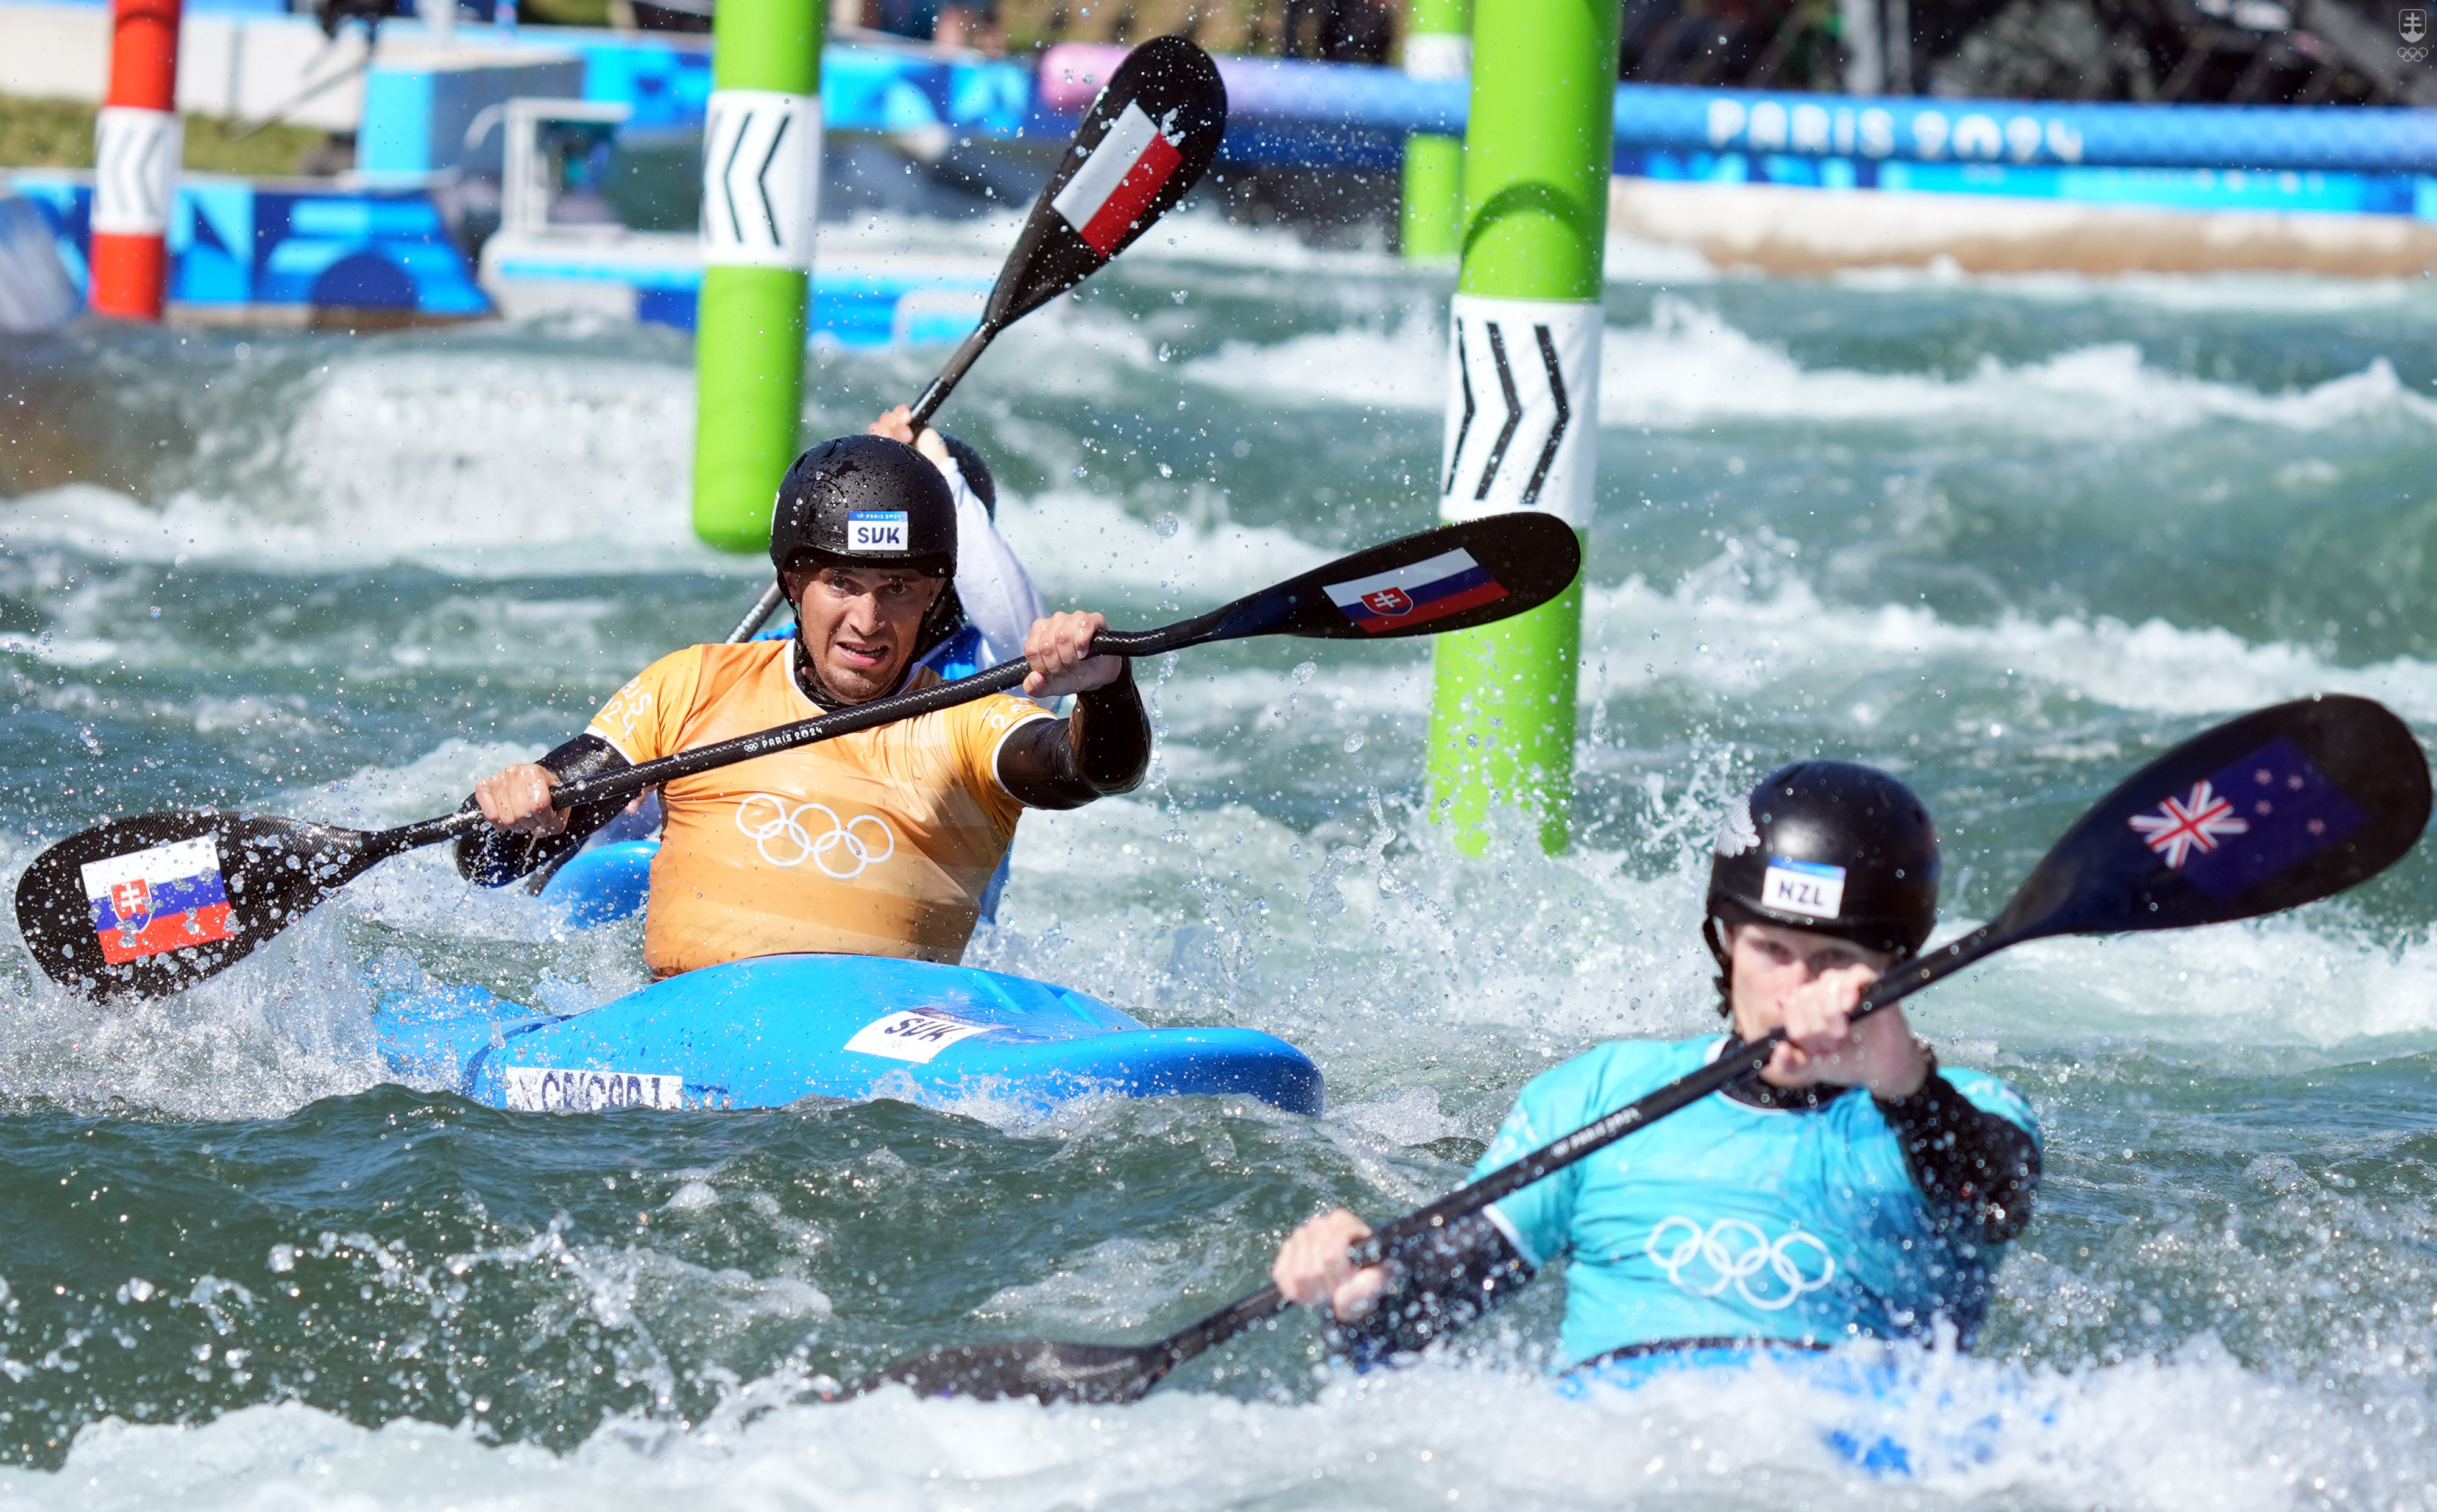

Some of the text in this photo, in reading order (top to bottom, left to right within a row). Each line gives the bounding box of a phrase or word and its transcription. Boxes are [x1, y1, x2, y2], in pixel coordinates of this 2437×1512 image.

[1708, 99, 2084, 163] PARIS 2024
[857, 526, 899, 544] SVK
[762, 726, 822, 749] PARIS 2024
[1778, 879, 1825, 906] NZL
[883, 1018, 967, 1042] SVK
